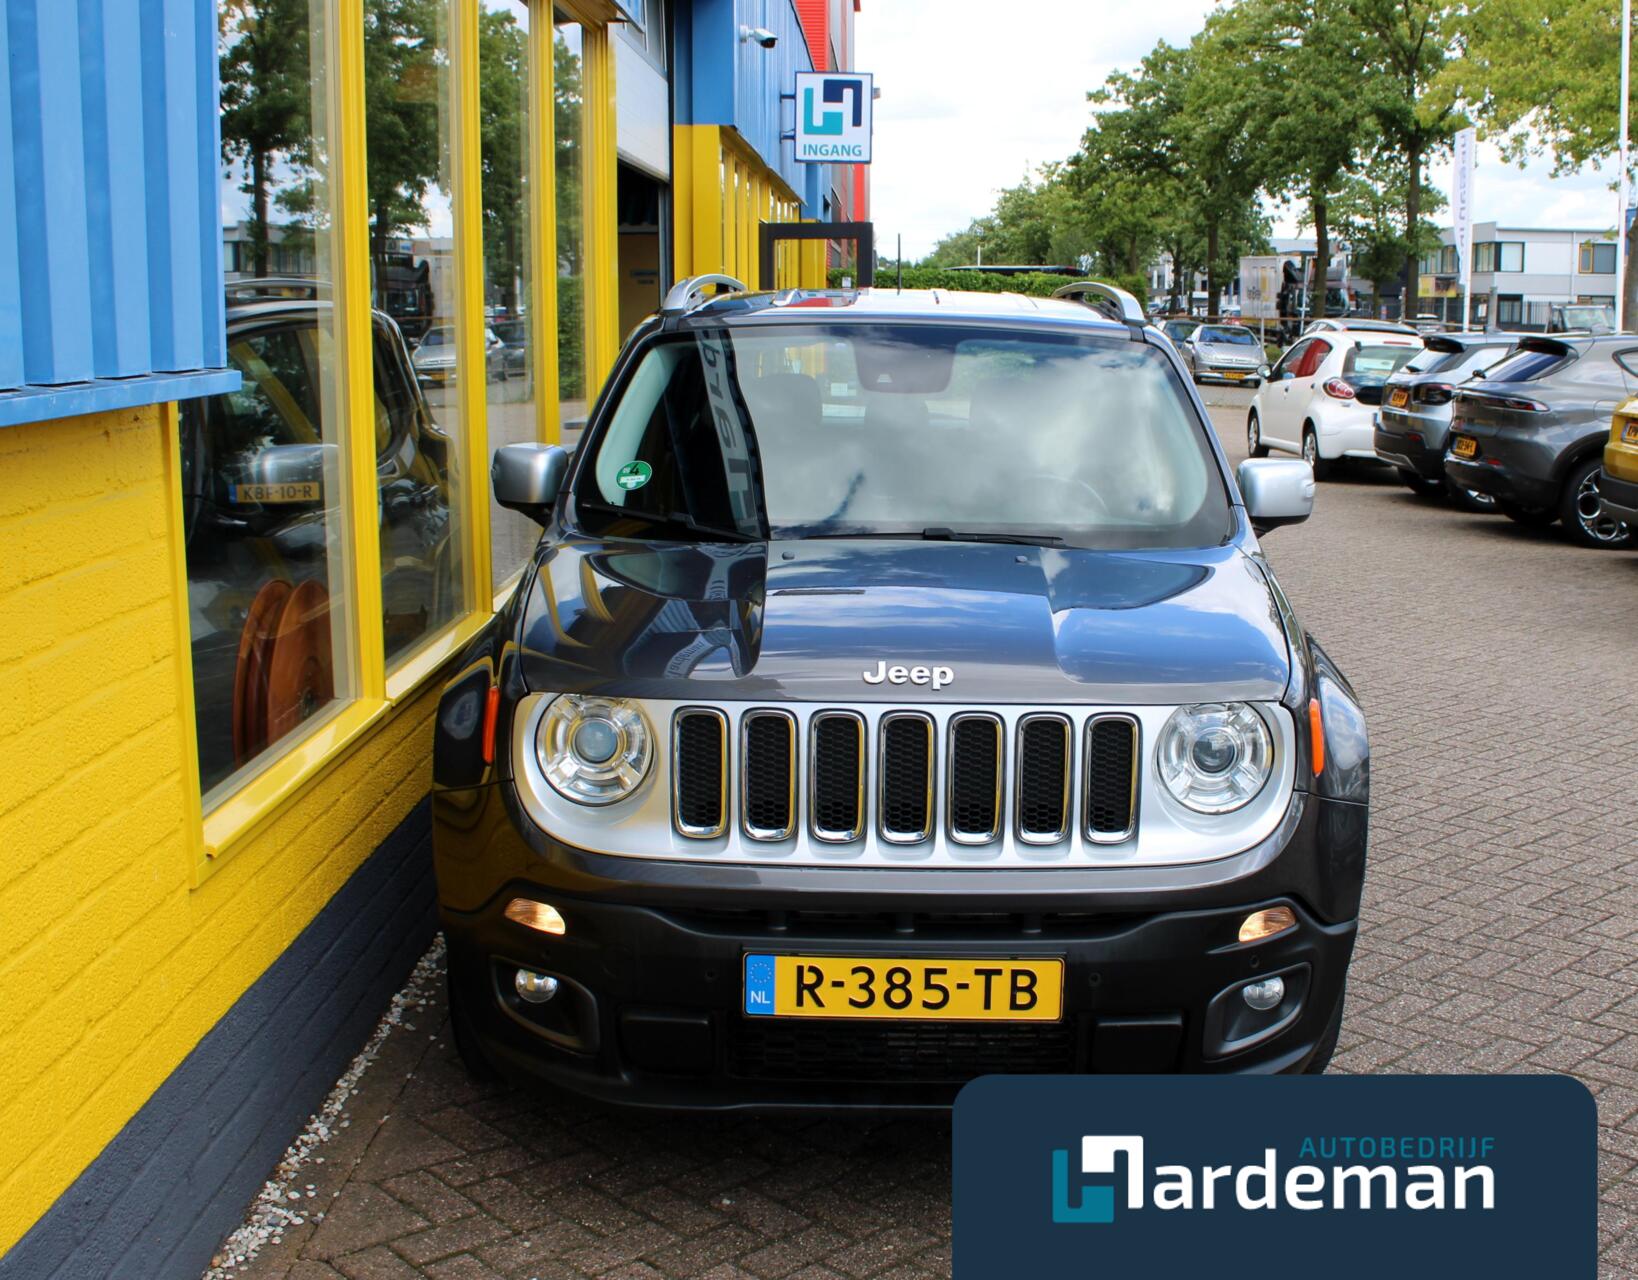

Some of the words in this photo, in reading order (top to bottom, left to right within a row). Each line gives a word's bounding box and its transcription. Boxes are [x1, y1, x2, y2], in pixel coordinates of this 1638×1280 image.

[803, 143, 863, 157] INGANG
[629, 462, 640, 475] 4
[863, 660, 955, 690] Jeep
[795, 964, 1039, 1012] R-385-TB
[750, 990, 771, 1004] NL
